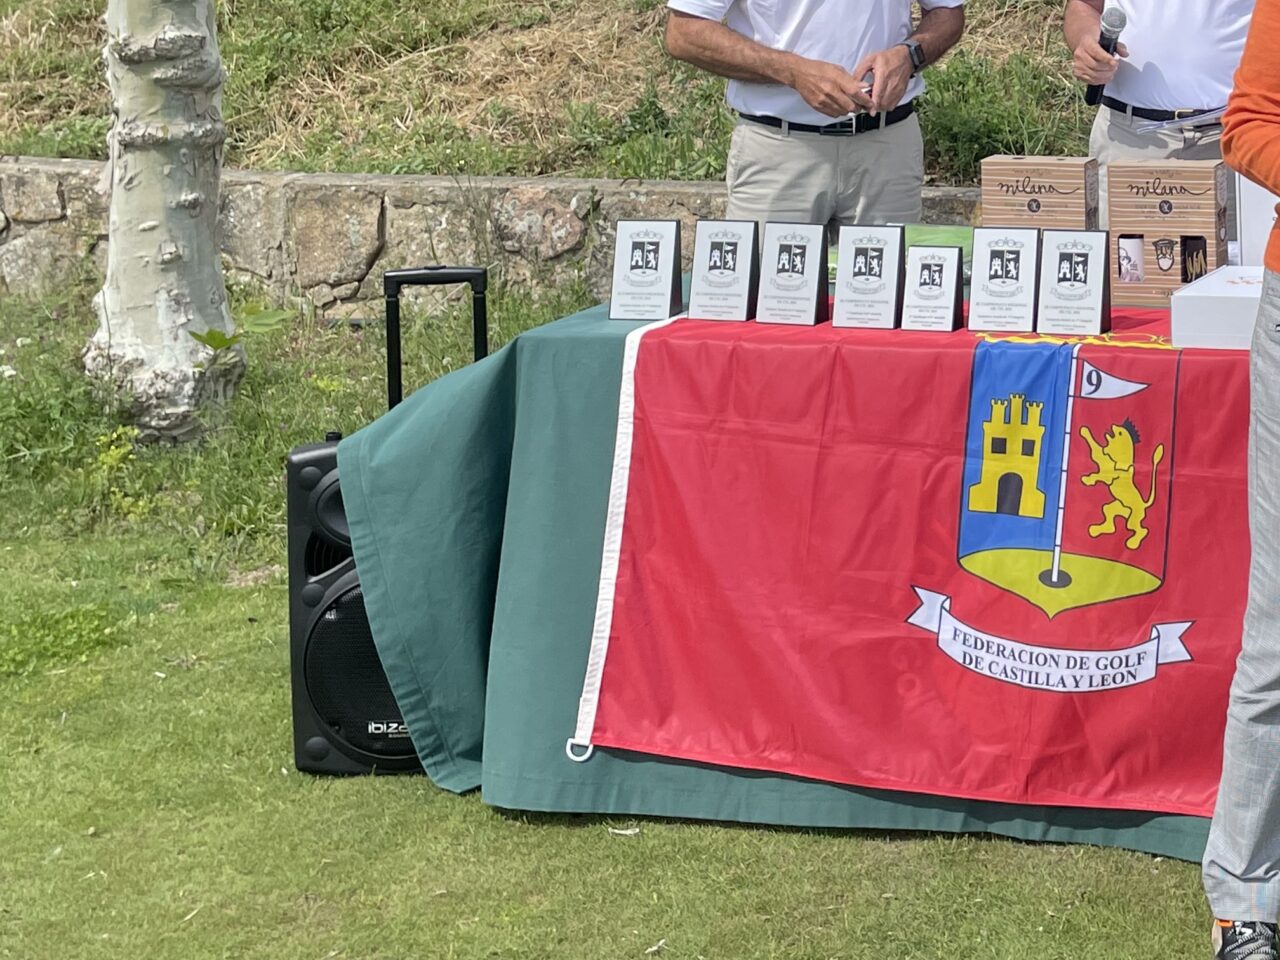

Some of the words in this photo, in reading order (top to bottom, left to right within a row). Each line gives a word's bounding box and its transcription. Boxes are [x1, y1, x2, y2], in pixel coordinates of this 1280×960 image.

[1085, 369, 1103, 396] 9
[952, 626, 1060, 670] FEDERACION
[1066, 656, 1090, 671] DE
[1095, 651, 1147, 671] GOLF
[962, 651, 984, 671] DE
[988, 660, 1068, 688] CASTILLA
[1071, 675, 1084, 689] Y
[1088, 668, 1139, 688] LEON
